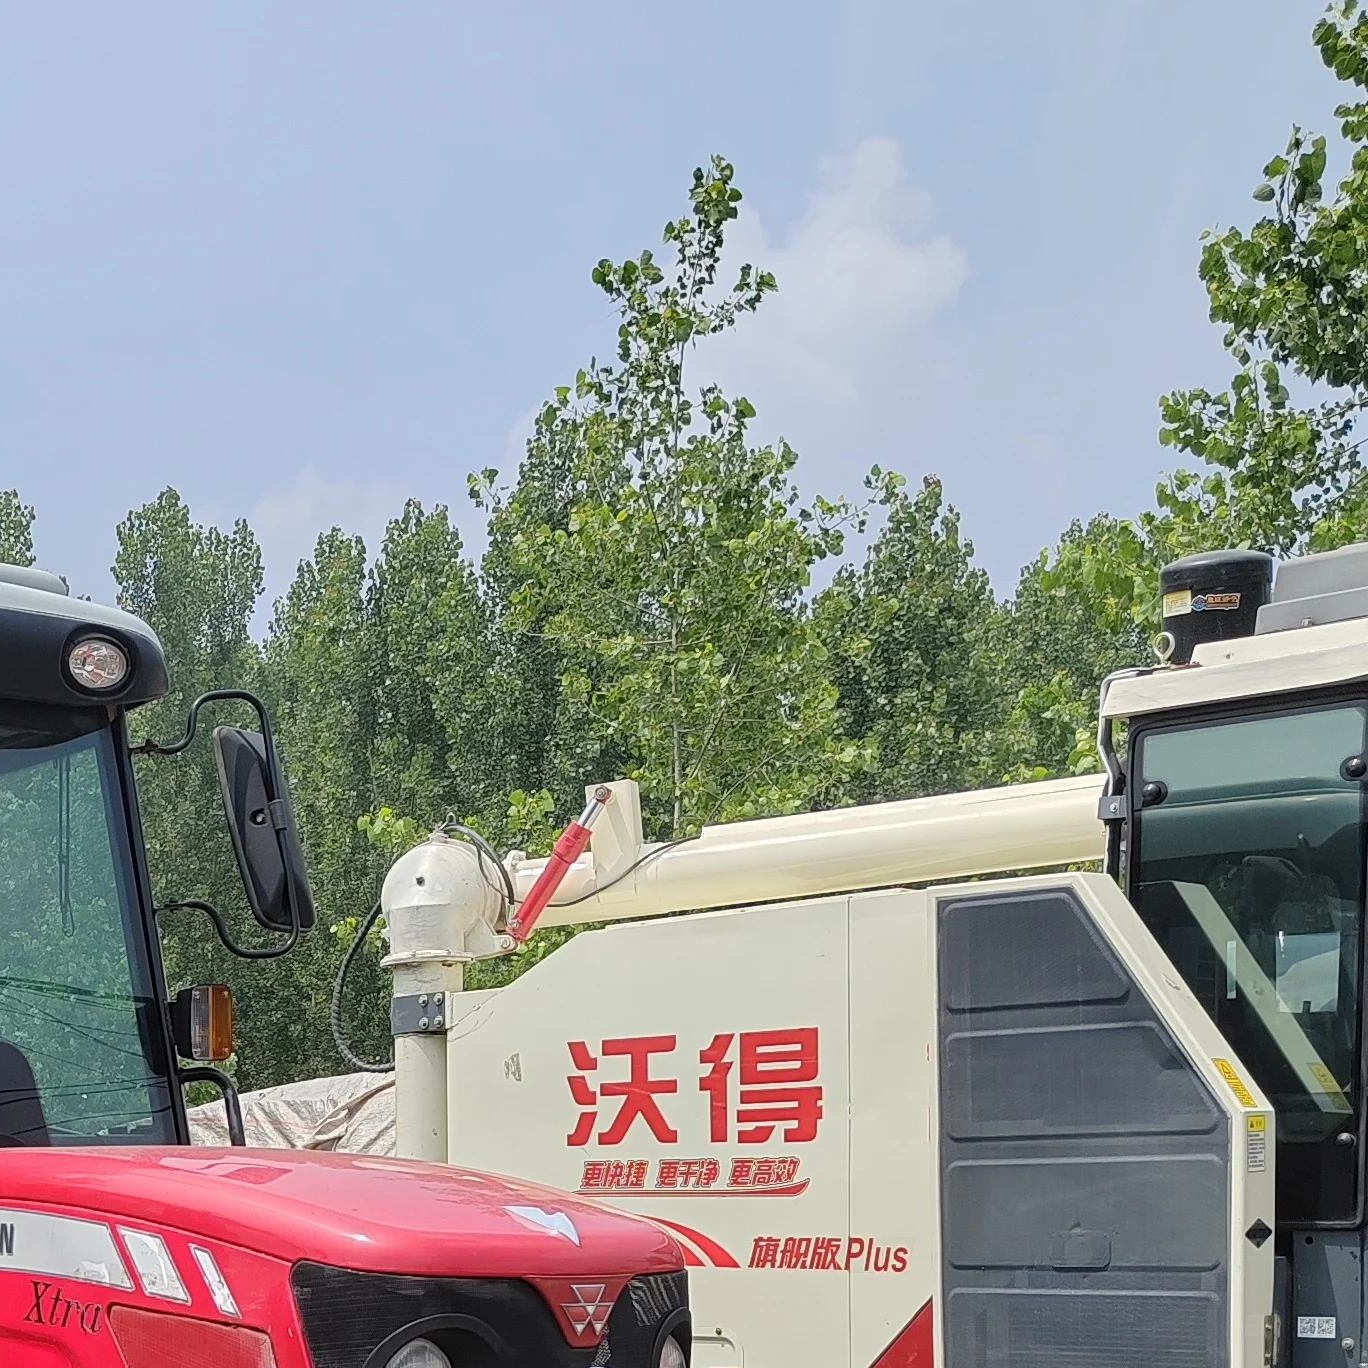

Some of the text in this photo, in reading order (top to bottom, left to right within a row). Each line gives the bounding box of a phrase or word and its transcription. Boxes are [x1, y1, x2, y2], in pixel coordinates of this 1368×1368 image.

[567, 1027, 823, 1147] 沃得
[581, 1156, 800, 1188] 更快捷 更干净 更高效
[23, 1279, 104, 1334] Xtra
